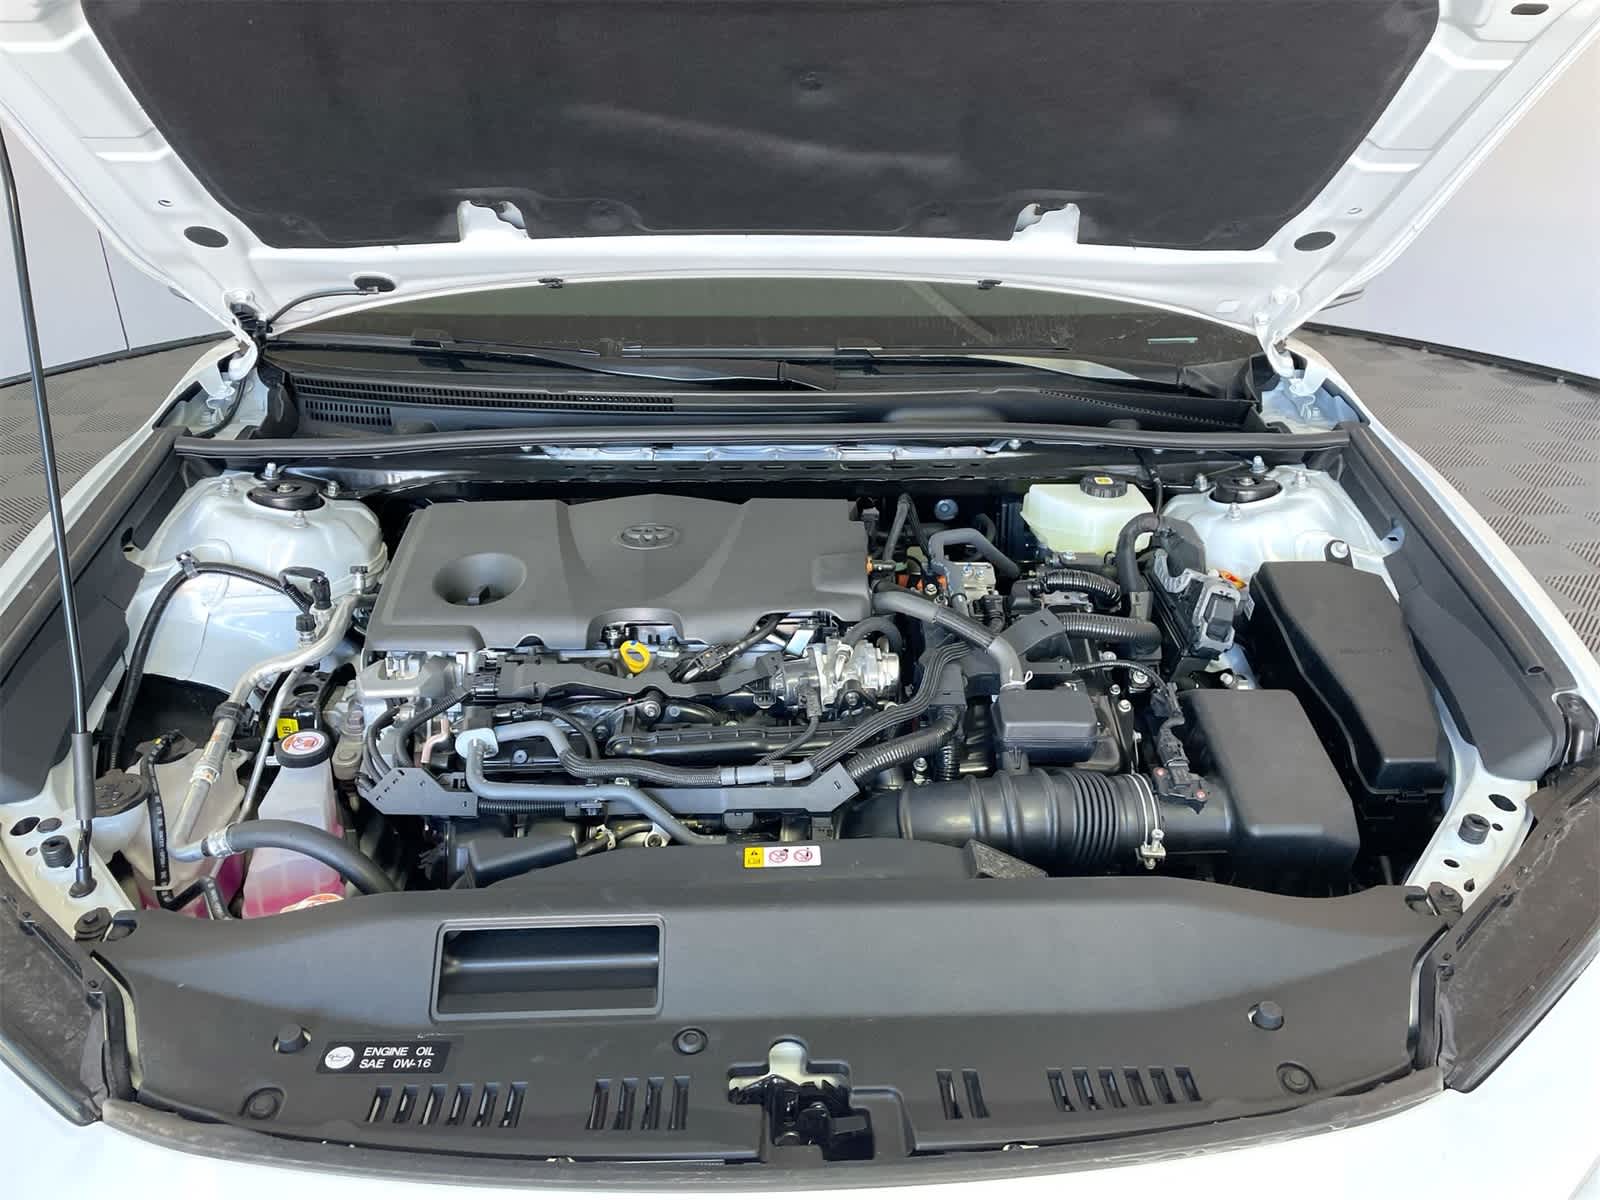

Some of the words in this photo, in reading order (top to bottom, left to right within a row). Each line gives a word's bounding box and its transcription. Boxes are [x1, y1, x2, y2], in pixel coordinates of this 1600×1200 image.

[363, 1046, 409, 1056] ENGINE
[415, 1046, 435, 1056] OIL
[359, 1058, 386, 1069] SAE
[392, 1058, 432, 1069] 0W-16
